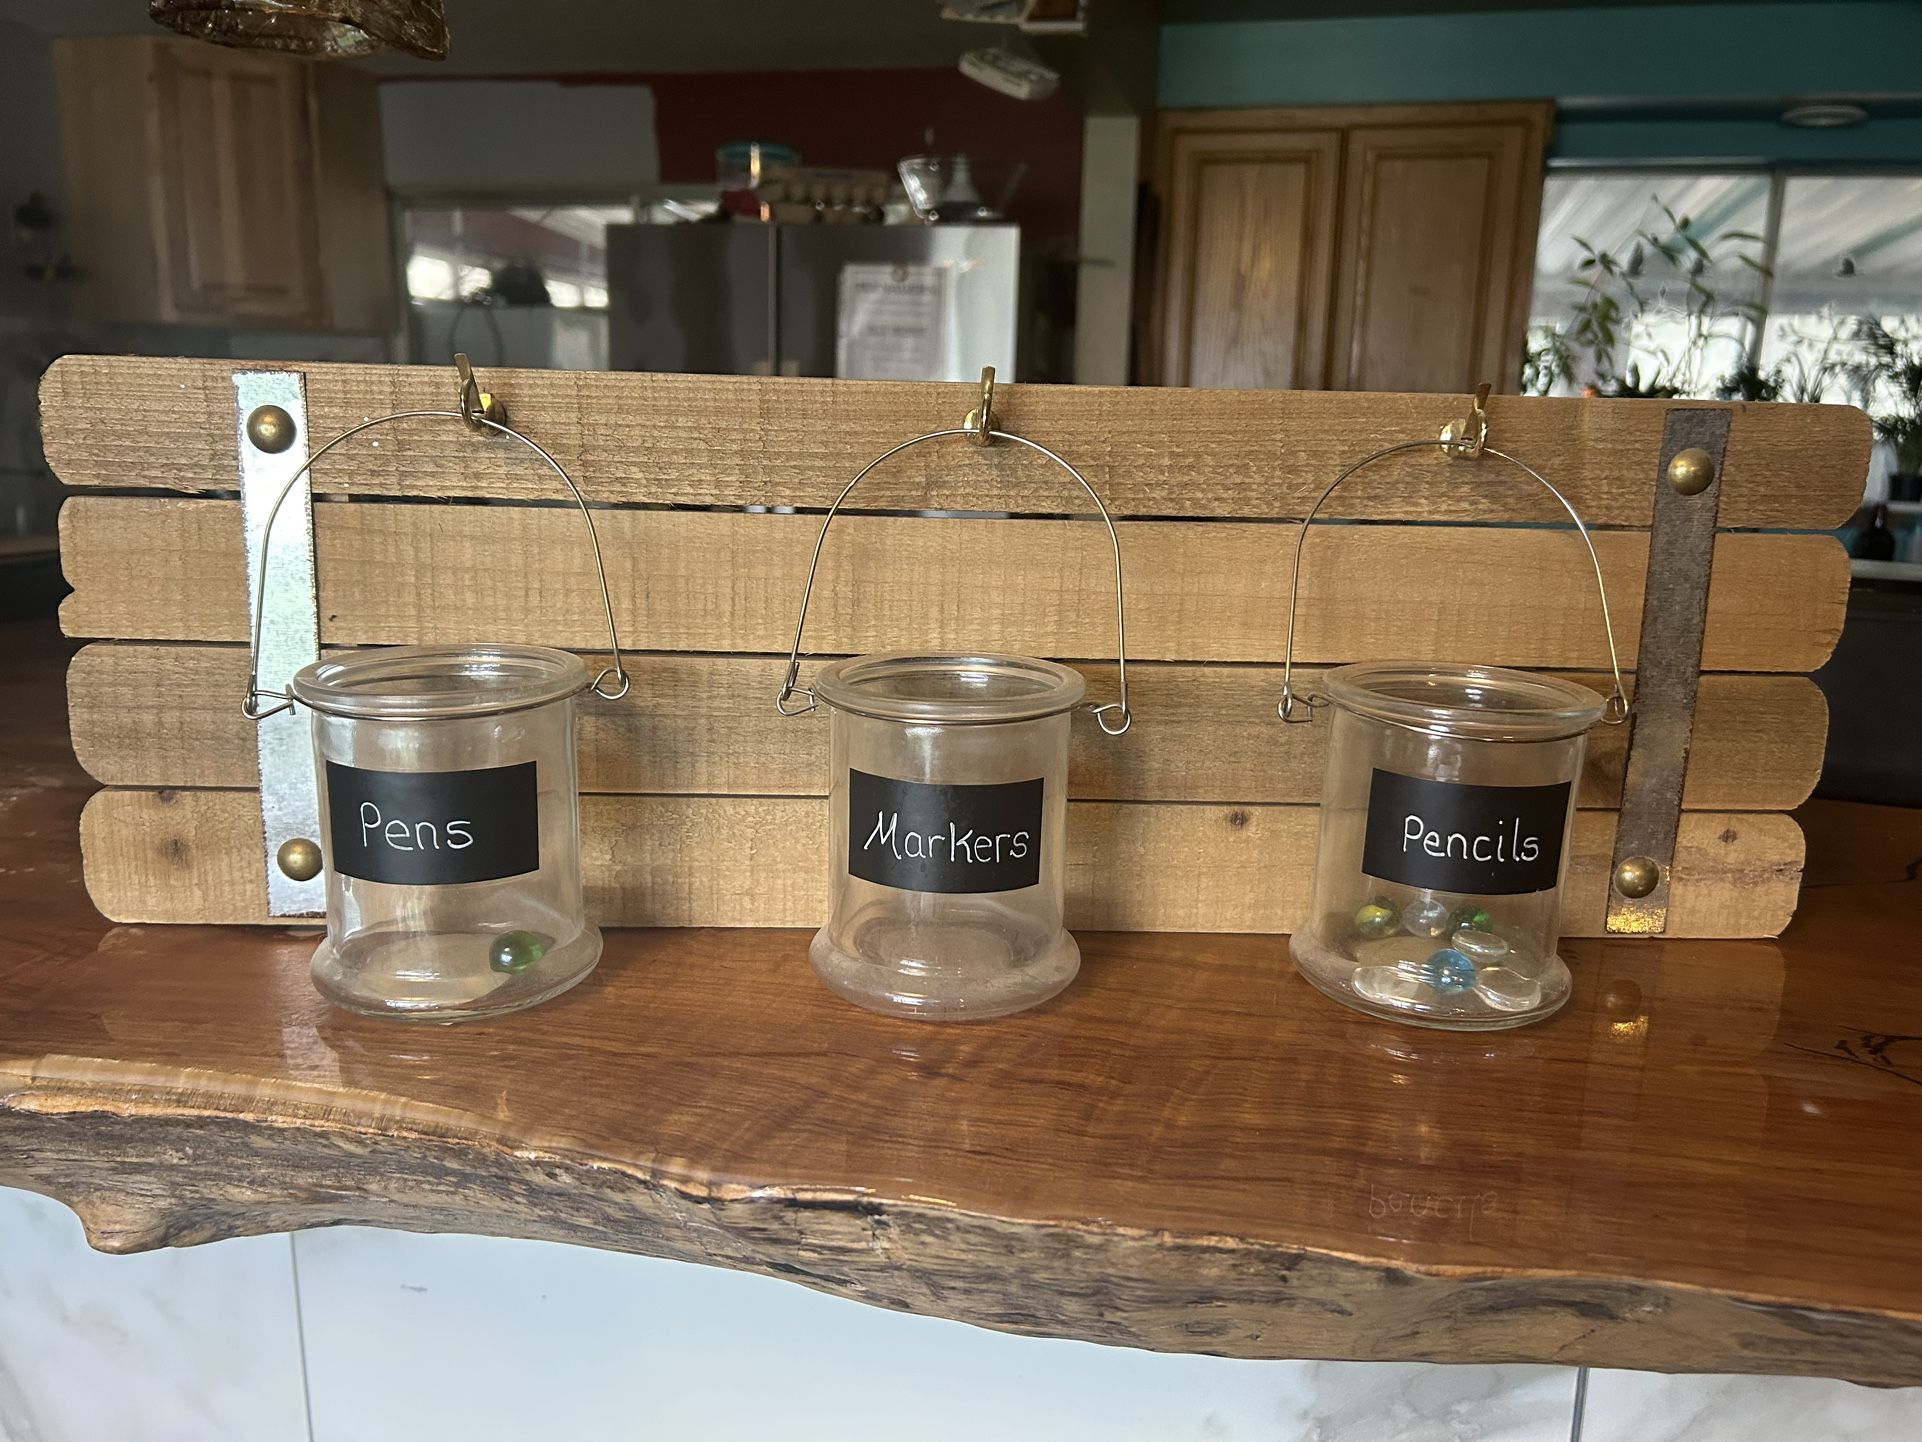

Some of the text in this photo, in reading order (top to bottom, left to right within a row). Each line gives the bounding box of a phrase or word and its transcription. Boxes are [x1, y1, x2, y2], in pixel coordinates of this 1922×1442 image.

[360, 801, 474, 851] Pens
[863, 810, 1030, 863] Markers
[1402, 814, 1540, 863] Pencils
